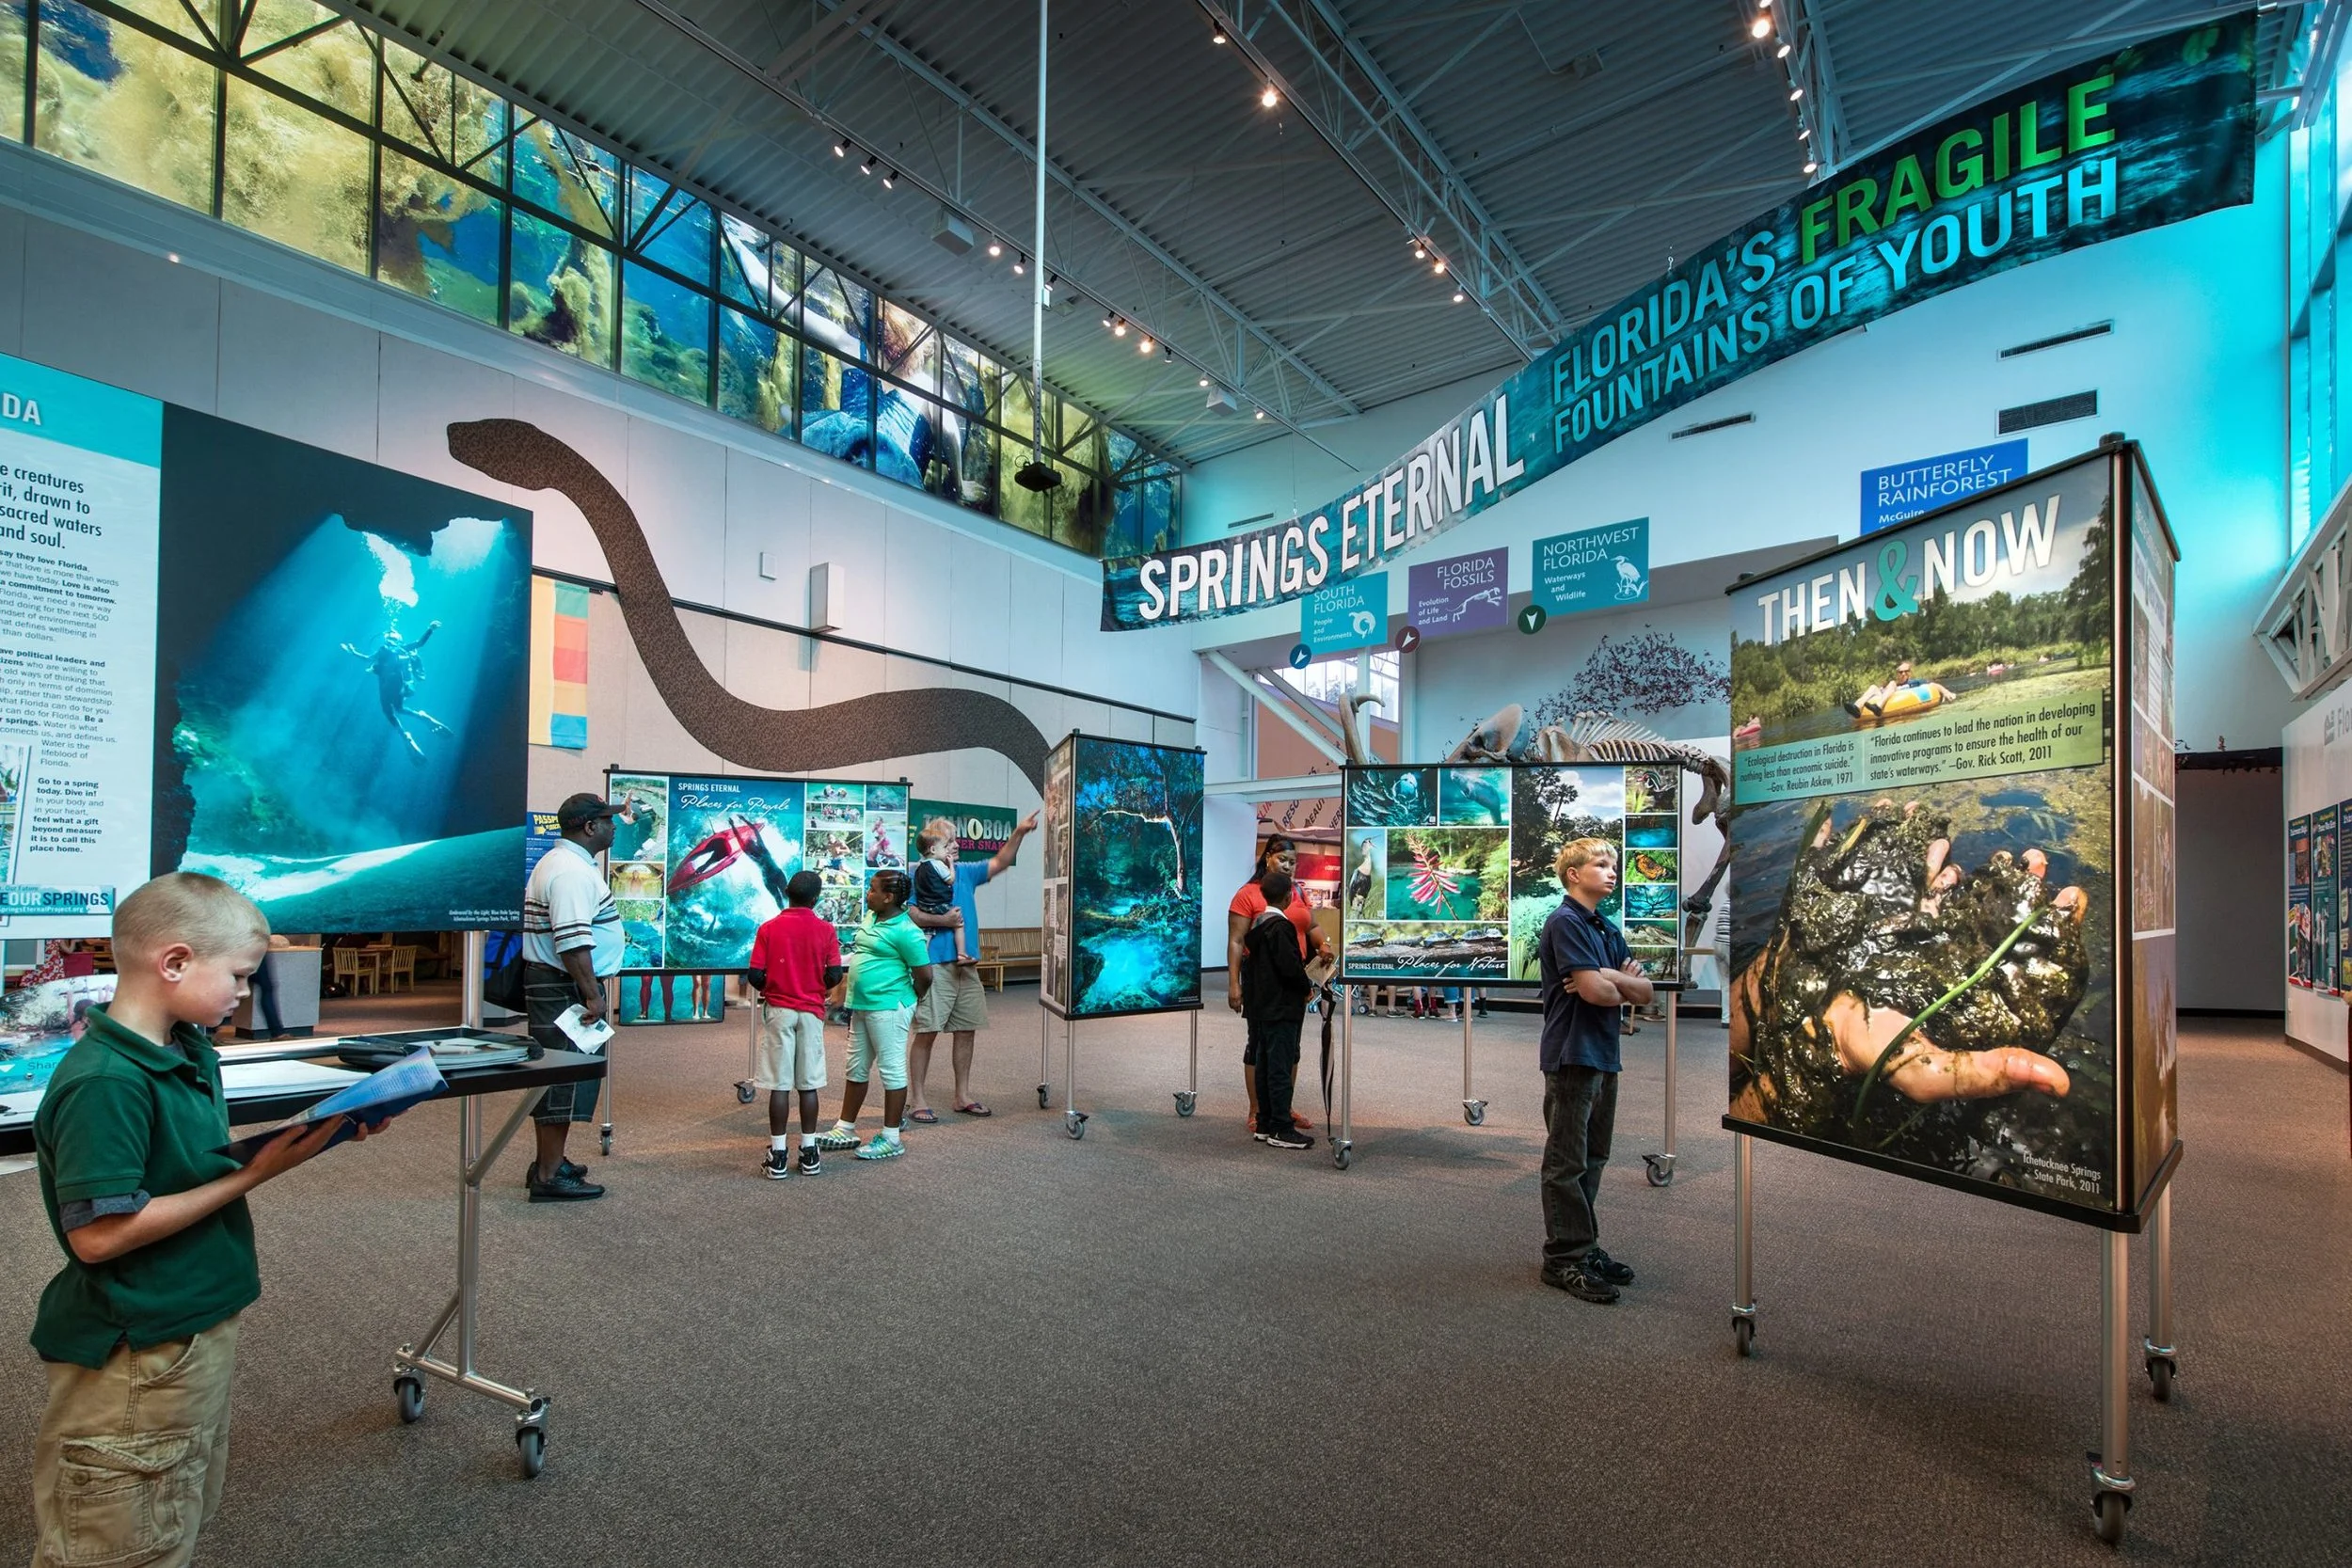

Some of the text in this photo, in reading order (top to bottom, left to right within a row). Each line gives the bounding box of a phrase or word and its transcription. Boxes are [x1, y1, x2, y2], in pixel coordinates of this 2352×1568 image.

[1553, 72, 2117, 404] FLORIDA'S FRAGILE
[1553, 157, 2117, 453] FOUNTAINS OF YOUTH
[14, 467, 84, 494] creatures
[1879, 454, 1994, 490] BUTTERFLY
[1878, 468, 2011, 507] RAINFOREST
[24, 485, 71, 510] drawn
[76, 500, 90, 515] to
[1138, 393, 1524, 621] SPRINGS ETERNAL
[0, 505, 102, 536] sacred waters
[30, 532, 66, 548] soul.
[1544, 527, 1639, 557] NORTHWEST
[16, 552, 35, 562] they
[38, 556, 56, 565] love
[1437, 557, 1494, 578] FLORIDA
[1544, 547, 1608, 571] FLORIDA
[1443, 569, 1494, 590] FOSSILS
[1544, 572, 1586, 584] Waterways
[1757, 561, 1867, 646] THEN
[1874, 539, 1918, 623] &
[1922, 494, 2061, 601] NOW
[14, 572, 34, 580] have
[37, 575, 60, 586] today.
[62, 580, 81, 589] Love
[1550, 583, 1565, 593] and
[8, 580, 63, 596] commitment
[76, 593, 117, 605] tomorrow.
[1313, 584, 1355, 603] SOUTH
[1419, 596, 1449, 608] Evolution
[1555, 590, 1586, 602] Wildlife
[1313, 595, 1365, 614] FLORIDA
[1313, 617, 1333, 626] People
[1418, 614, 1448, 626] and Land
[1313, 626, 1325, 635] and
[1313, 631, 1352, 643] Environments
[16, 650, 53, 660] political
[55, 655, 87, 665] leaders
[6, 718, 40, 727] springs.
[43, 721, 66, 729] Water
[1902, 728, 1941, 743] continues
[1944, 726, 1952, 736] to
[1954, 720, 1973, 735] lead
[1976, 718, 1991, 731] the
[1994, 715, 2024, 728] nation
[2026, 711, 2036, 723] in
[2039, 703, 2095, 721] developing
[41, 739, 65, 748] Water
[76, 741, 90, 750] the
[1777, 748, 1813, 762] destruction
[1814, 746, 1821, 756] in
[1822, 741, 1847, 755] Florida
[1848, 740, 1854, 751] is
[1870, 723, 2083, 765] innovative programs to ensure the health of our
[40, 758, 71, 768] Florida.
[41, 749, 77, 759] lifeblood
[1978, 752, 1996, 767] Rick
[2000, 751, 2026, 764] Scott,
[2028, 745, 2051, 761] 2011
[1740, 770, 1762, 782] nothing
[1763, 769, 1775, 779] less
[1776, 766, 1791, 776] than
[1792, 761, 1822, 775] economic
[1787, 780, 1809, 790] Reubin
[1810, 775, 1834, 787] Askew,
[1836, 771, 1853, 784] 1971
[37, 787, 63, 797] today.
[65, 788, 83, 797] Dive
[38, 777, 50, 785] Go
[72, 781, 99, 789] spring
[677, 783, 740, 793] SPRINGS ETERNAL
[66, 799, 86, 807] body
[680, 794, 790, 818] Places for People
[32, 825, 63, 834] beyond
[977, 840, 1006, 851] SNAK
[42, 892, 109, 906] SPRINGS
[1397, 955, 1509, 978] Places for Nature
[2023, 1152, 2101, 1181] Ichetucknee Springs
[2034, 1169, 2100, 1194] State Park, 2011
